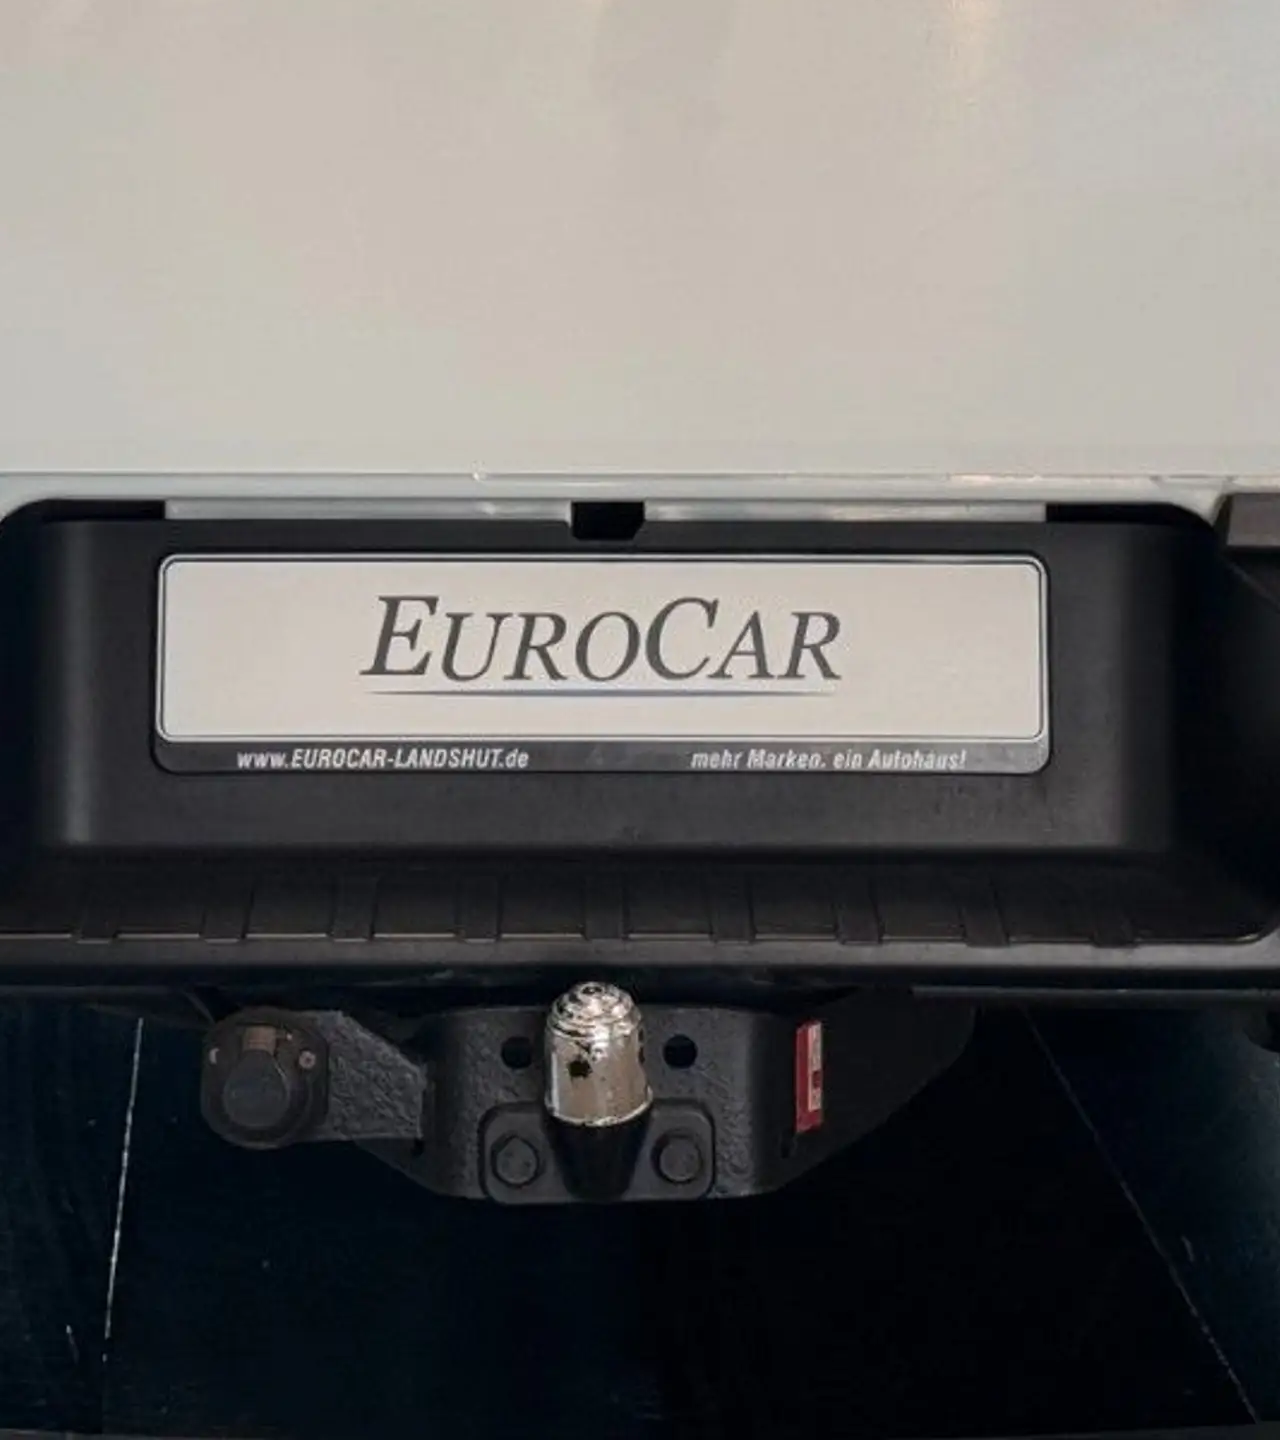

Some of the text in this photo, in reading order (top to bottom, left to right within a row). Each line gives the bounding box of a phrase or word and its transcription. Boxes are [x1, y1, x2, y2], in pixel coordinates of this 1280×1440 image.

[236, 748, 530, 769] www.EUROCAR-LANDSHUT.de
[690, 750, 742, 769] mehr
[832, 750, 864, 769] ein
[868, 749, 968, 769] Autohaus!
